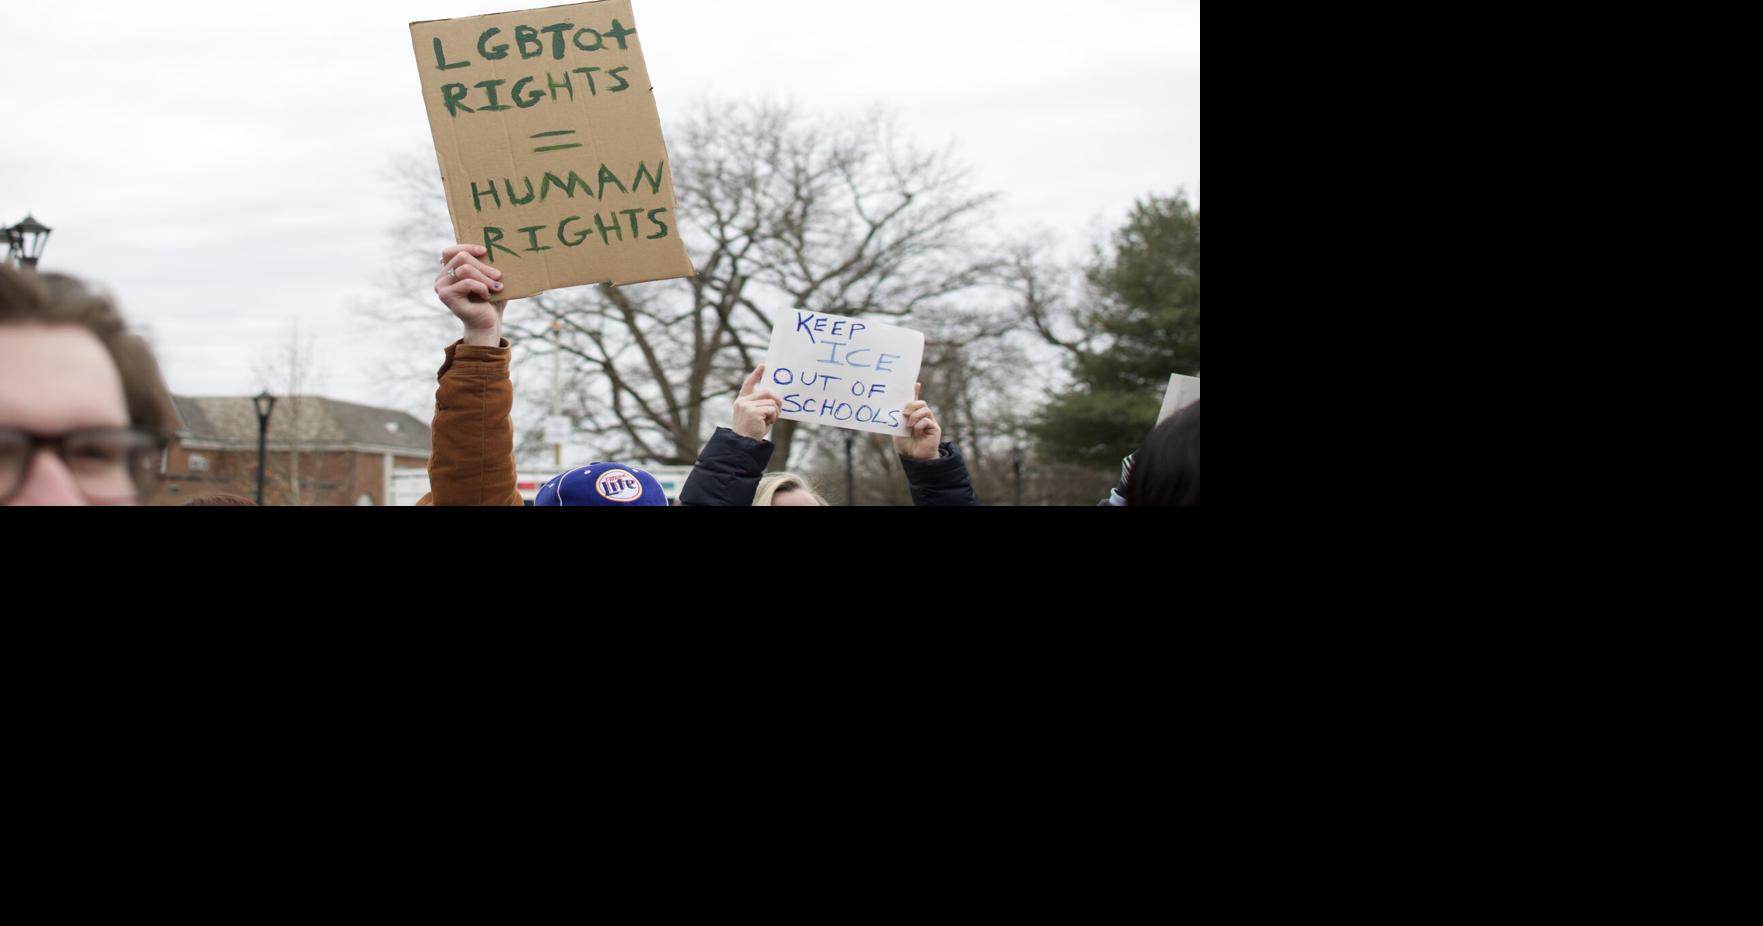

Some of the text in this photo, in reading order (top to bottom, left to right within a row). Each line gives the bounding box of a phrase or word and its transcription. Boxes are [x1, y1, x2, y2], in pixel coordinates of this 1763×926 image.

[433, 19, 636, 70] LGBTQ+
[440, 65, 629, 117] RIGHTS
[529, 129, 583, 152] =
[470, 160, 664, 213] HUMAN
[483, 207, 669, 263] RIGHTS
[796, 312, 866, 344] KEEP
[816, 340, 900, 372] ICE
[773, 368, 886, 398] OUT OF
[781, 394, 900, 428] SCHOOLS
[601, 479, 636, 497] Lite
